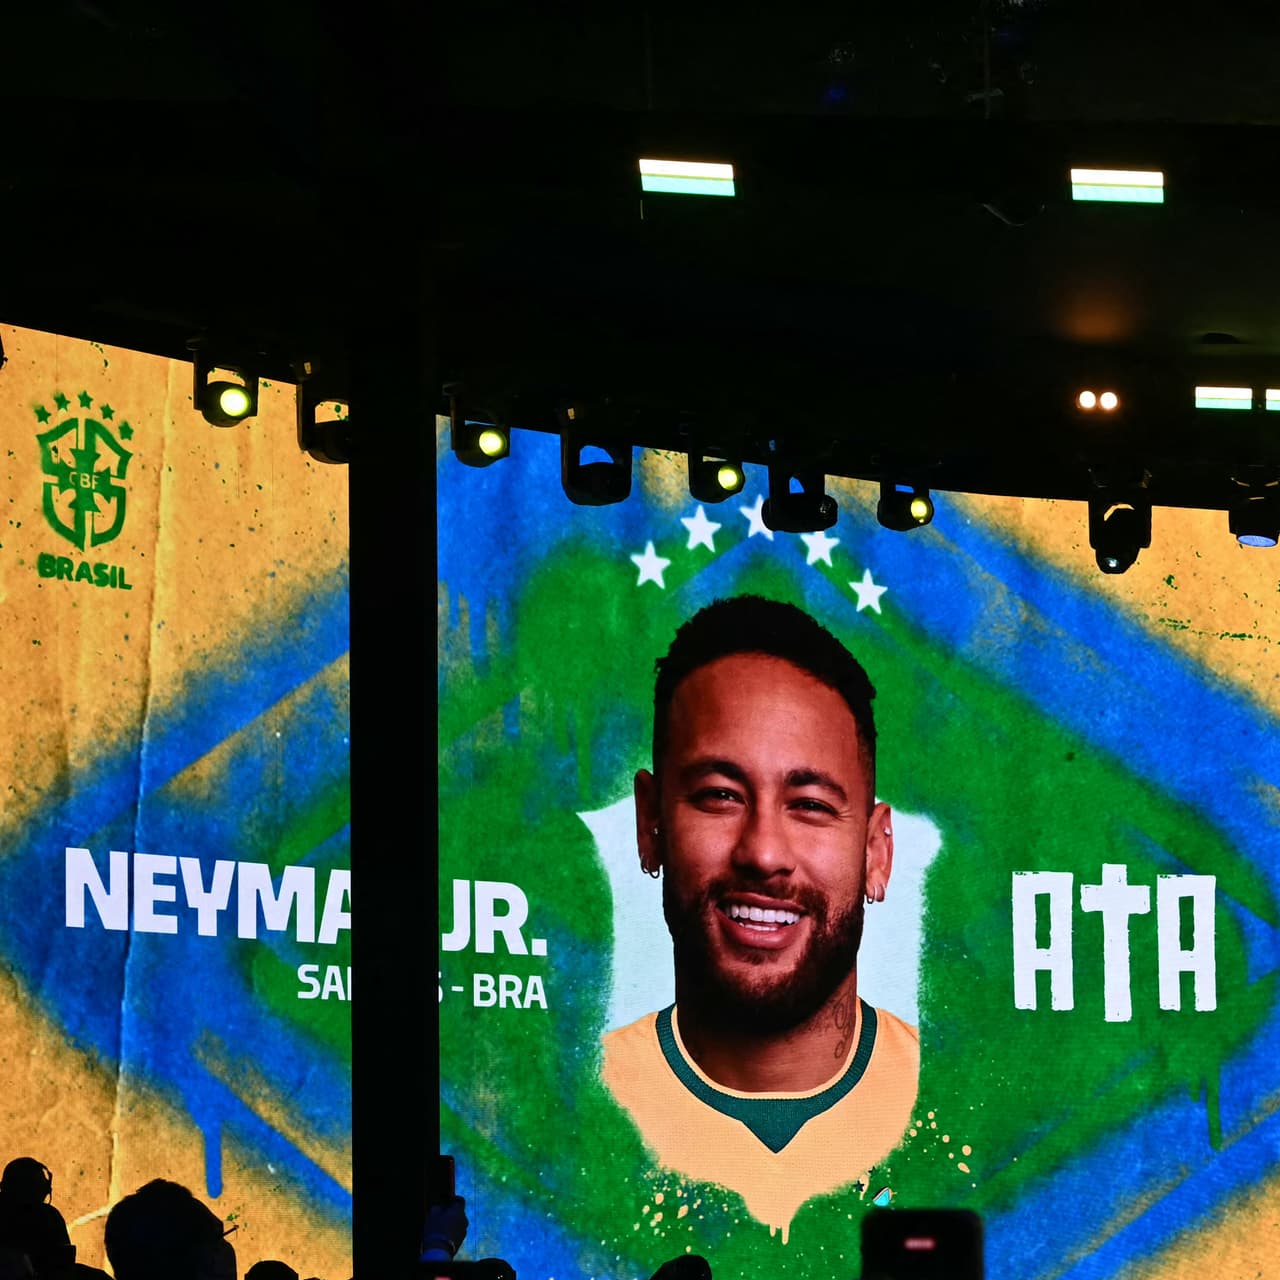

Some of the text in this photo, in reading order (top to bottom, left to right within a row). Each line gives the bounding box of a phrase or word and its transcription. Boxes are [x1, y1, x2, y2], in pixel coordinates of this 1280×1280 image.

[38, 553, 132, 590] BRASIL
[65, 846, 548, 956] NEYMA JR.
[1011, 863, 1217, 1022] ATA
[473, 973, 548, 1010] BRA
